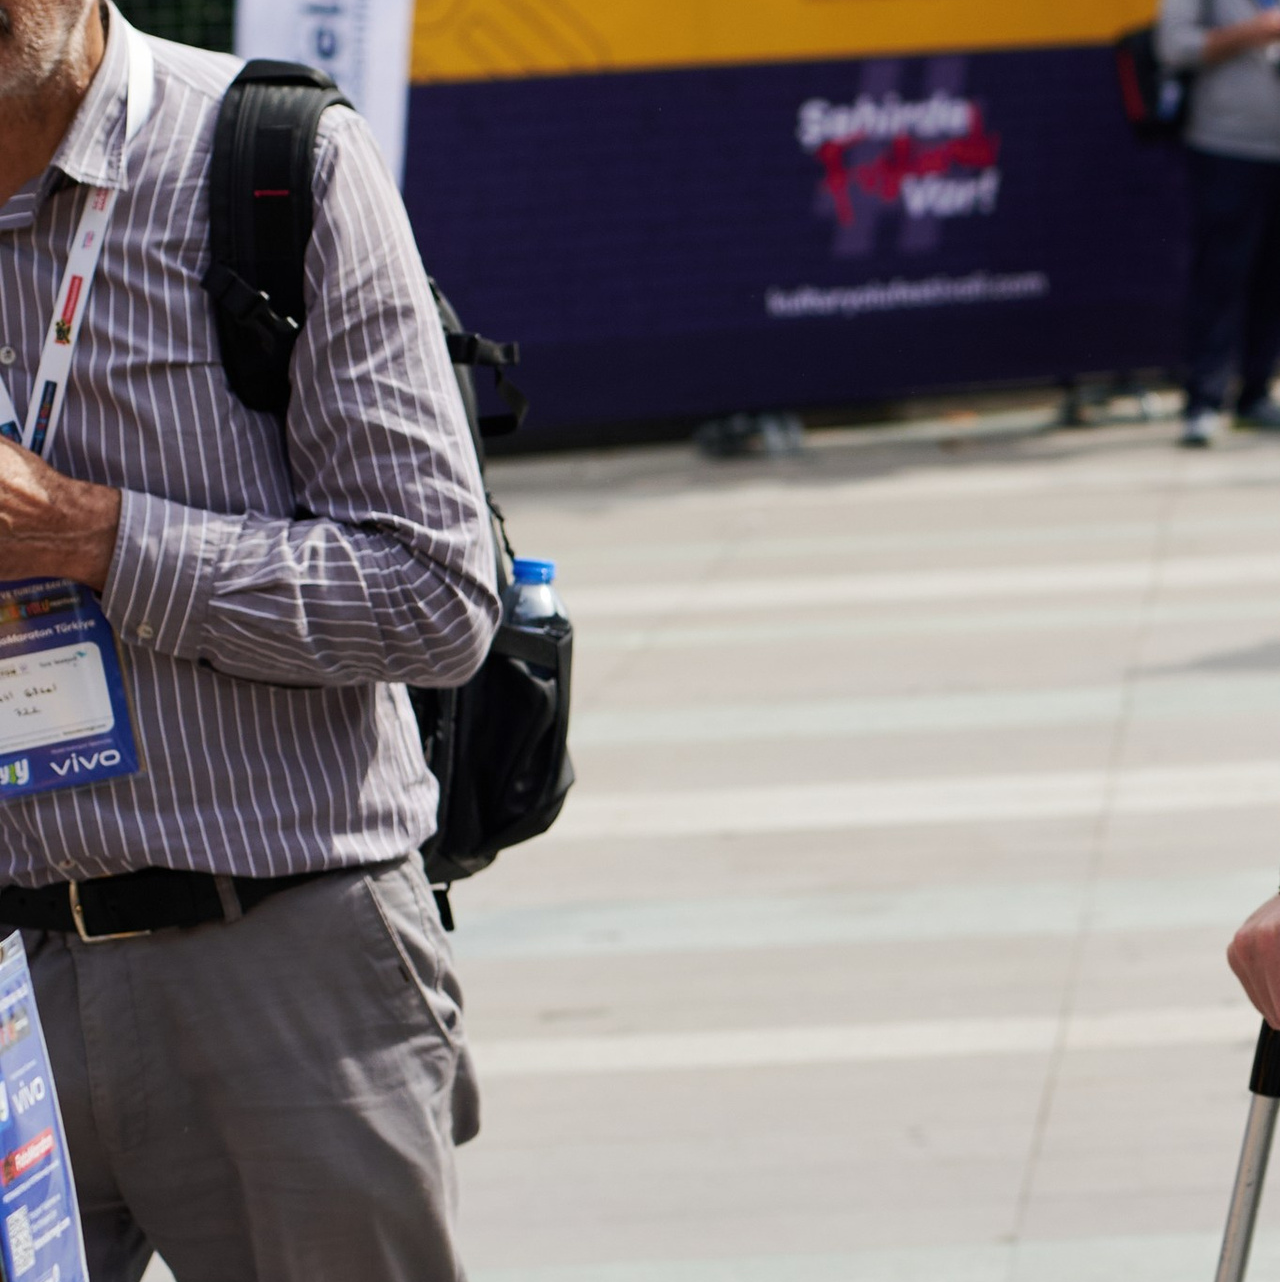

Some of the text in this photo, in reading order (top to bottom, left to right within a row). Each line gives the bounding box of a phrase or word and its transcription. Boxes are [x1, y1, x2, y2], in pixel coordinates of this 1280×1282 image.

[901, 167, 999, 217] Var!
[49, 749, 121, 777] vivo
[12, 1075, 46, 1115] vivo
